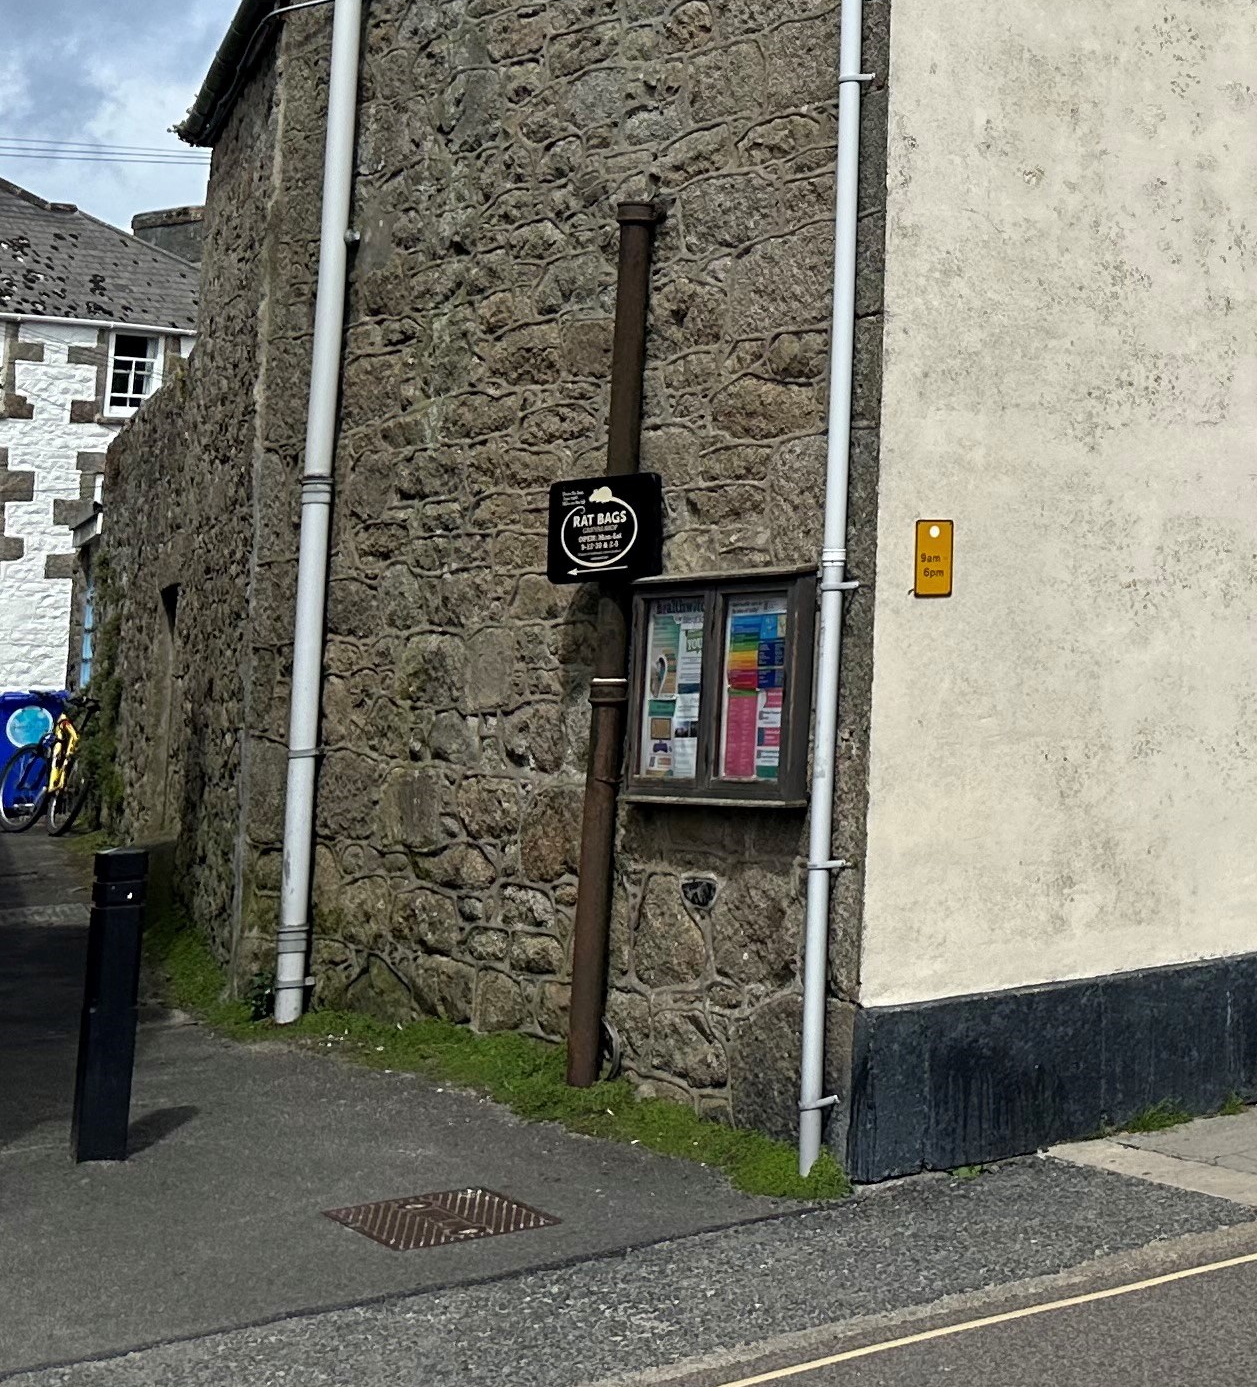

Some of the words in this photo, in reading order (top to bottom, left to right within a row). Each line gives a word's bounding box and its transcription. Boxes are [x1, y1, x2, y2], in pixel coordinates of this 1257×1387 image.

[573, 514, 595, 529] RAT
[597, 510, 627, 526] BAGS
[923, 567, 944, 579] 6pm
